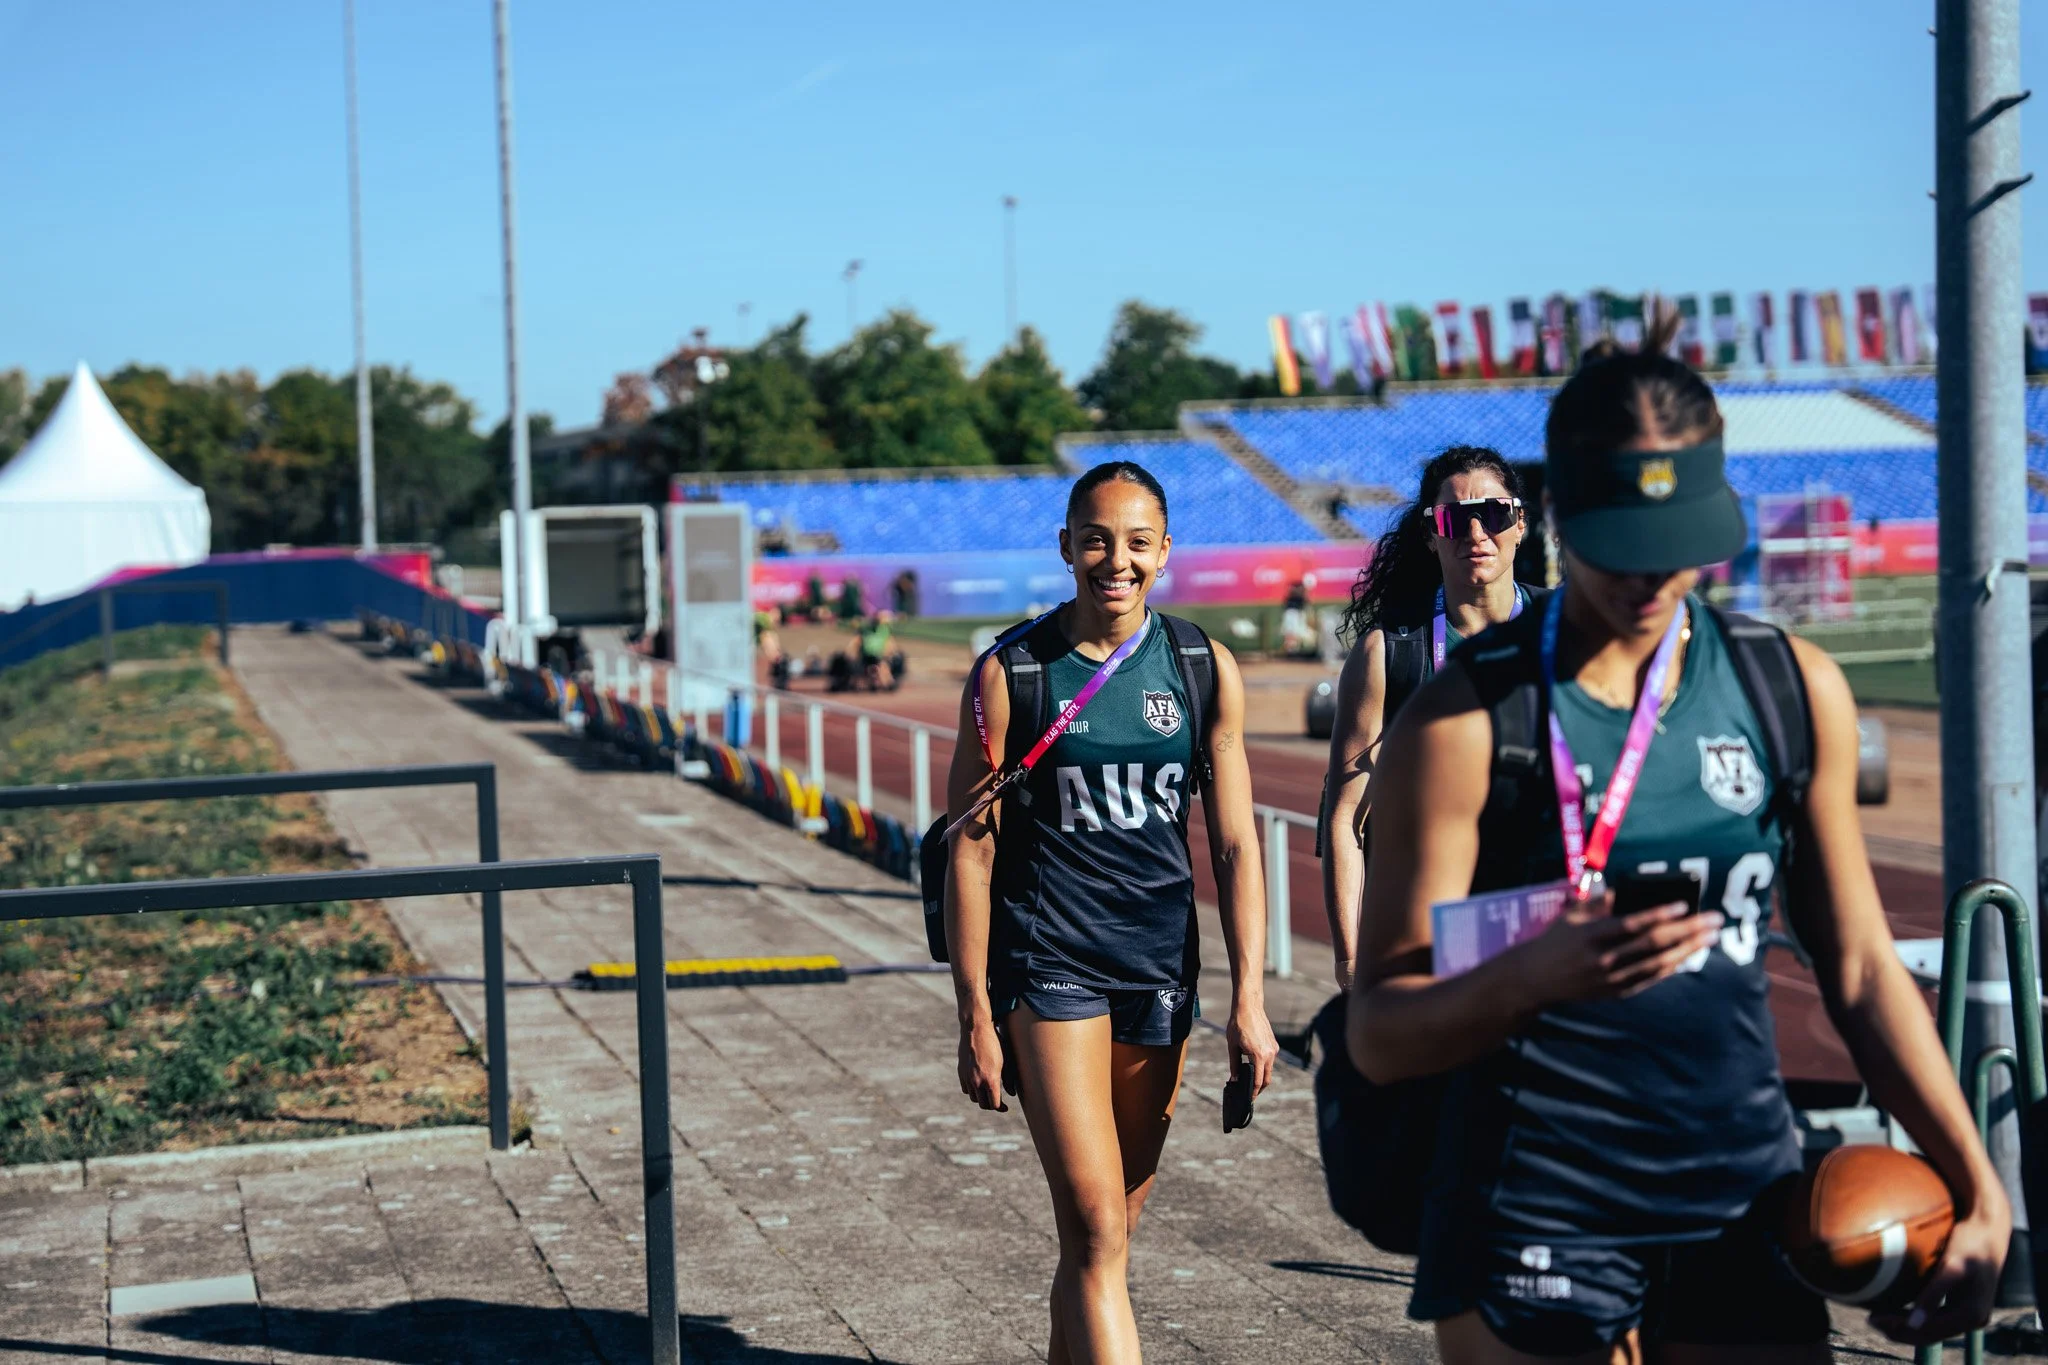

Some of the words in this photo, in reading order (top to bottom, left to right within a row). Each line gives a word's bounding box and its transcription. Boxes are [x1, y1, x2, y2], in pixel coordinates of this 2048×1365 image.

[1146, 699, 1180, 717] AFA
[977, 712, 985, 726] THE
[1043, 725, 1059, 744] FLAG
[1055, 715, 1069, 730] THE
[1065, 702, 1081, 719] CITY.
[978, 726, 988, 745] FLAG
[1056, 763, 1184, 832] AUS
